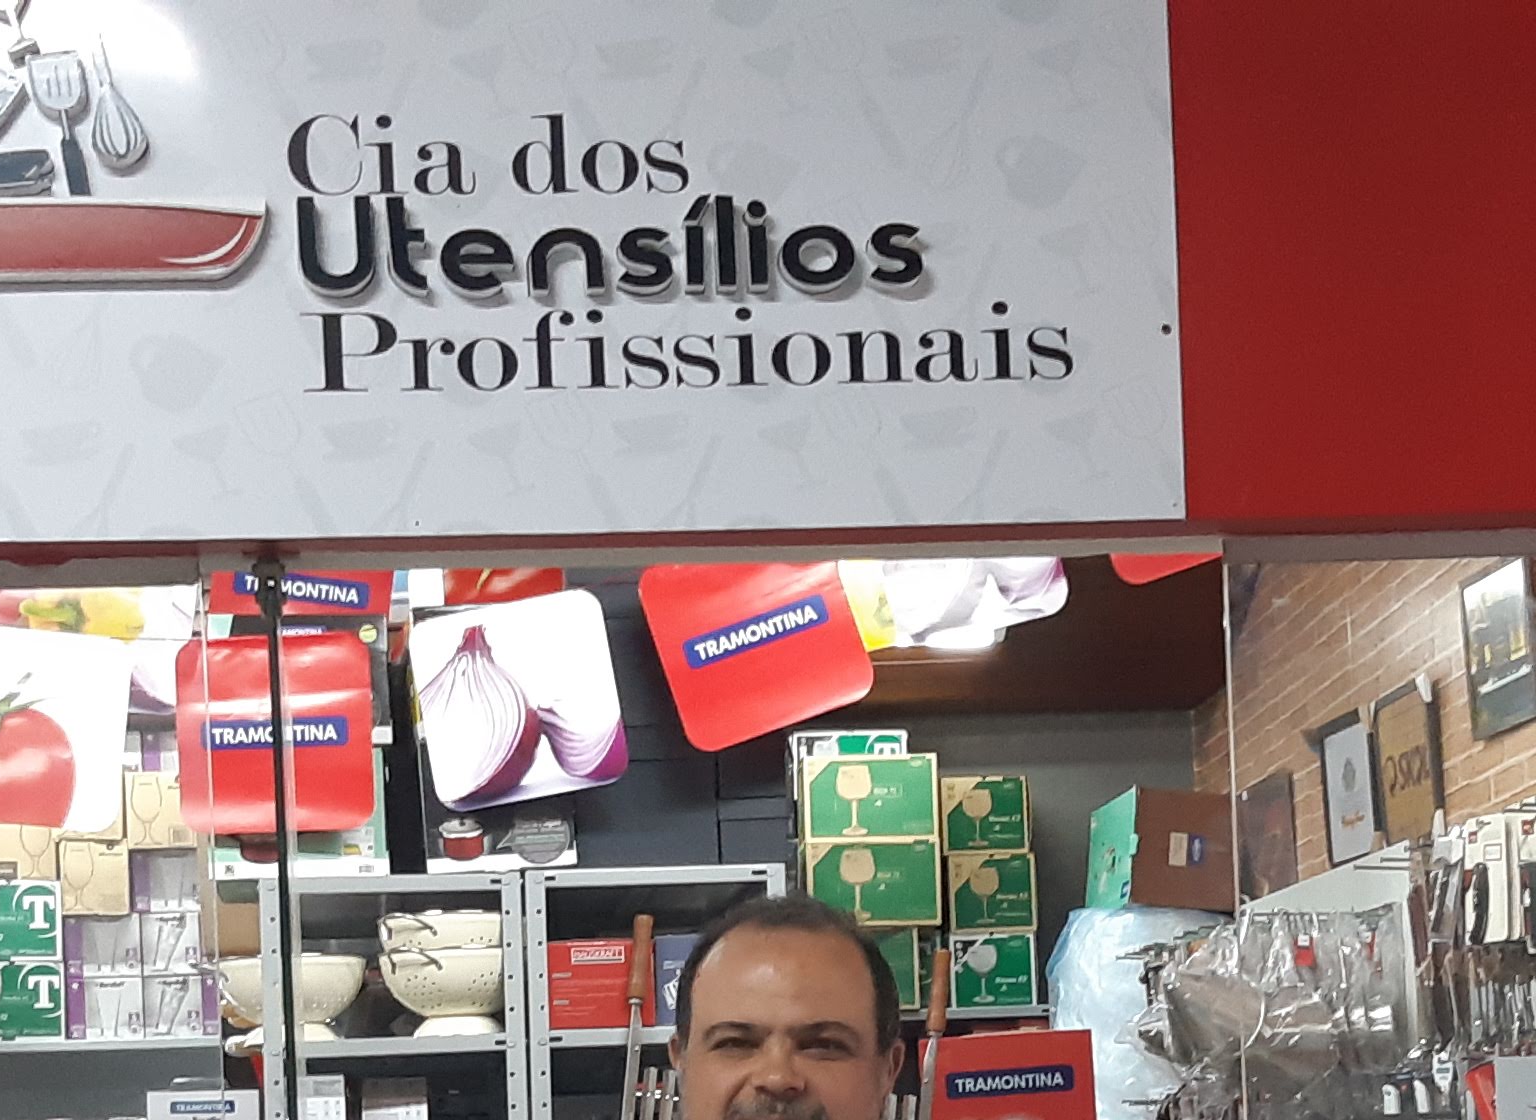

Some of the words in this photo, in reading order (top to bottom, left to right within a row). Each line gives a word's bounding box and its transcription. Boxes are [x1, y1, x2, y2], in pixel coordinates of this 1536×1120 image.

[288, 112, 476, 202] Cia
[512, 114, 689, 199] dos
[297, 194, 929, 300] Utensílios
[301, 303, 1075, 396] Profissionais
[244, 573, 359, 604] TMONTINA
[694, 603, 819, 662] TRAMONTINA
[212, 724, 338, 745] TRAMOTINA
[955, 1071, 1063, 1093] TRAMONTINA
